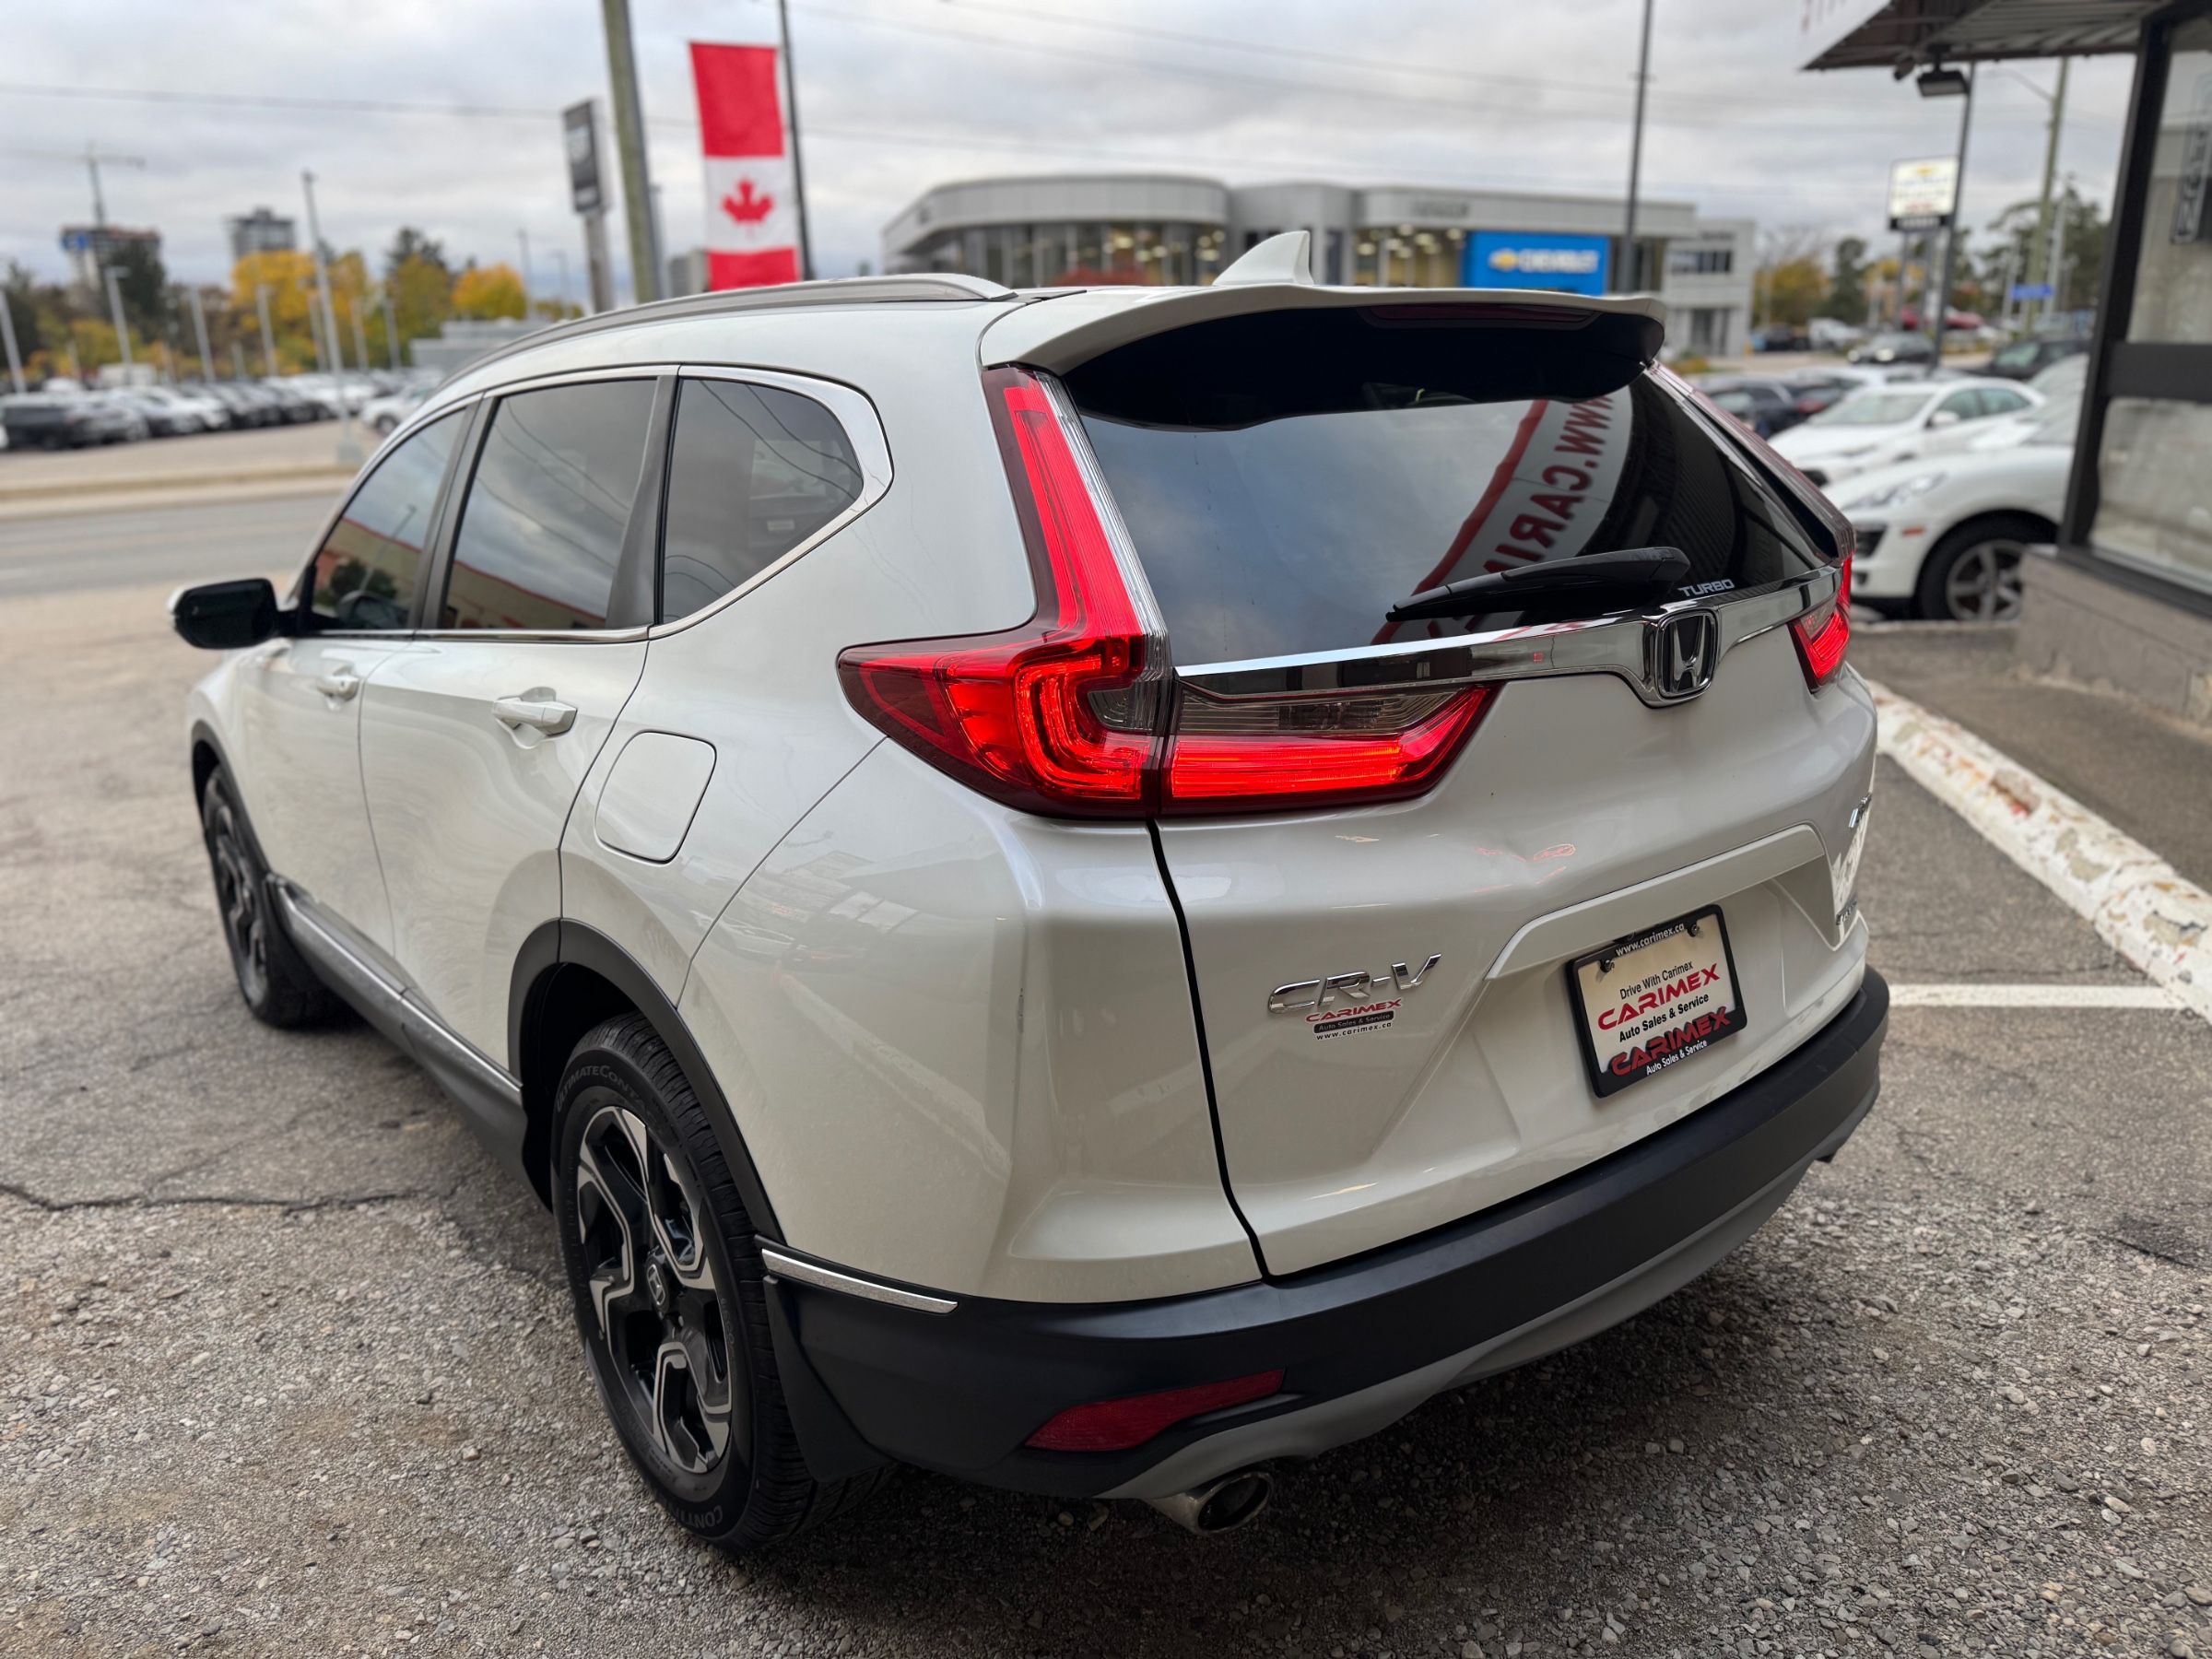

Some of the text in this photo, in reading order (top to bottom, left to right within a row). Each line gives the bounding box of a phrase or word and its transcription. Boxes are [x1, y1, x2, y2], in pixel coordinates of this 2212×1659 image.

[1677, 578, 1735, 597] TURBO
[1615, 923, 1685, 957] www.carimex.ca
[1267, 953, 1442, 1014] CR-V
[1597, 962, 1721, 1030] CARIMEX
[1619, 960, 1694, 1000] Drive With Carimex
[1305, 998, 1404, 1022] CARIMEX
[1318, 1023, 1336, 1032] Auto
[1337, 1019, 1357, 1029] Sales
[1365, 1014, 1391, 1023] Service
[1619, 994, 1710, 1042] Auto Sales & Service
[1316, 1022, 1392, 1041] www.carimex.ca
[1611, 1006, 1731, 1076] CARIMEX
[1646, 1039, 1708, 1076] Auto Sales & Service
